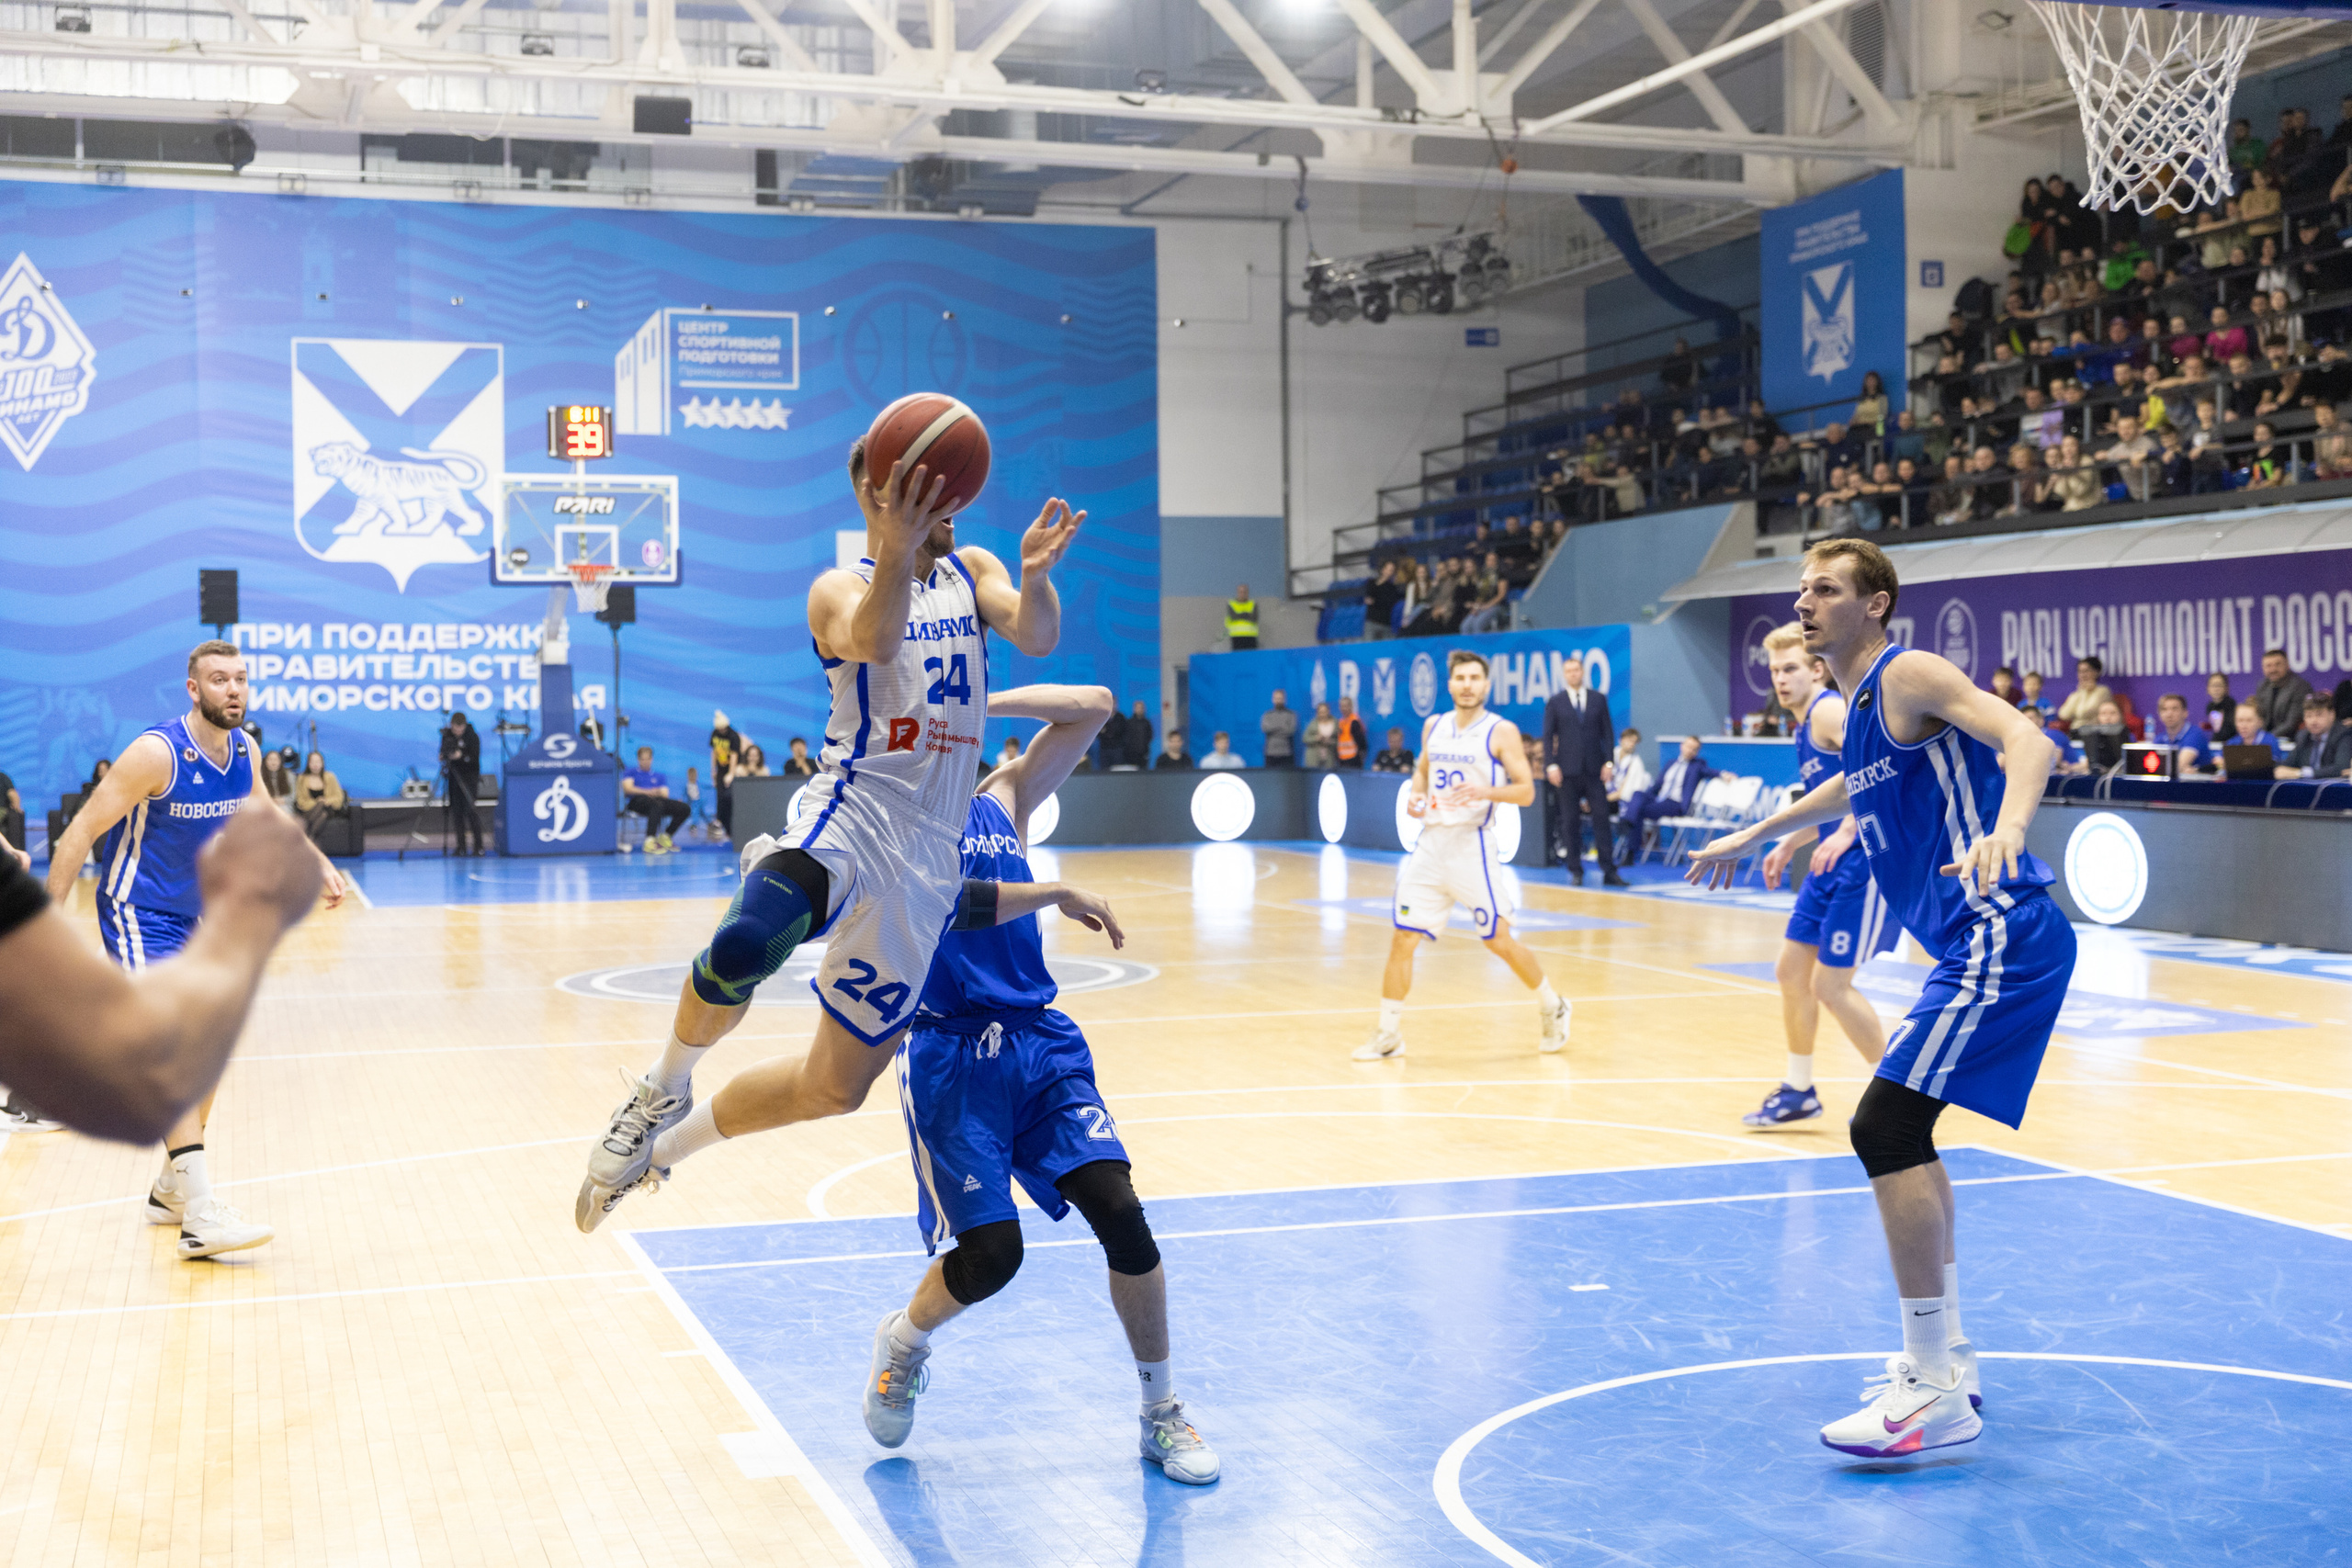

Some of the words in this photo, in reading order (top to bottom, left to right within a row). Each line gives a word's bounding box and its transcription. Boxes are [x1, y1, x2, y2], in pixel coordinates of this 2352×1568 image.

[678, 321, 729, 334] ЦЕНТР
[678, 335, 781, 350] СПОРТИВНОЙ
[678, 350, 779, 365] ПОДГОТОВКИ
[0, 389, 78, 417] ИНАМО
[567, 423, 604, 457] 39
[554, 496, 616, 514] PARI
[232, 623, 312, 649] ПРИ
[2001, 607, 2064, 678] PARI
[923, 654, 971, 705] 24
[1486, 648, 1611, 705] ИНАМО
[247, 684, 493, 711] ИМОРСКОГО
[504, 684, 606, 711] КЯ
[1435, 769, 1464, 791] 30
[1830, 931, 1852, 955] 8
[833, 958, 911, 1025] 24
[1077, 1103, 1122, 1143] 2
[963, 1181, 983, 1193] PEAK
